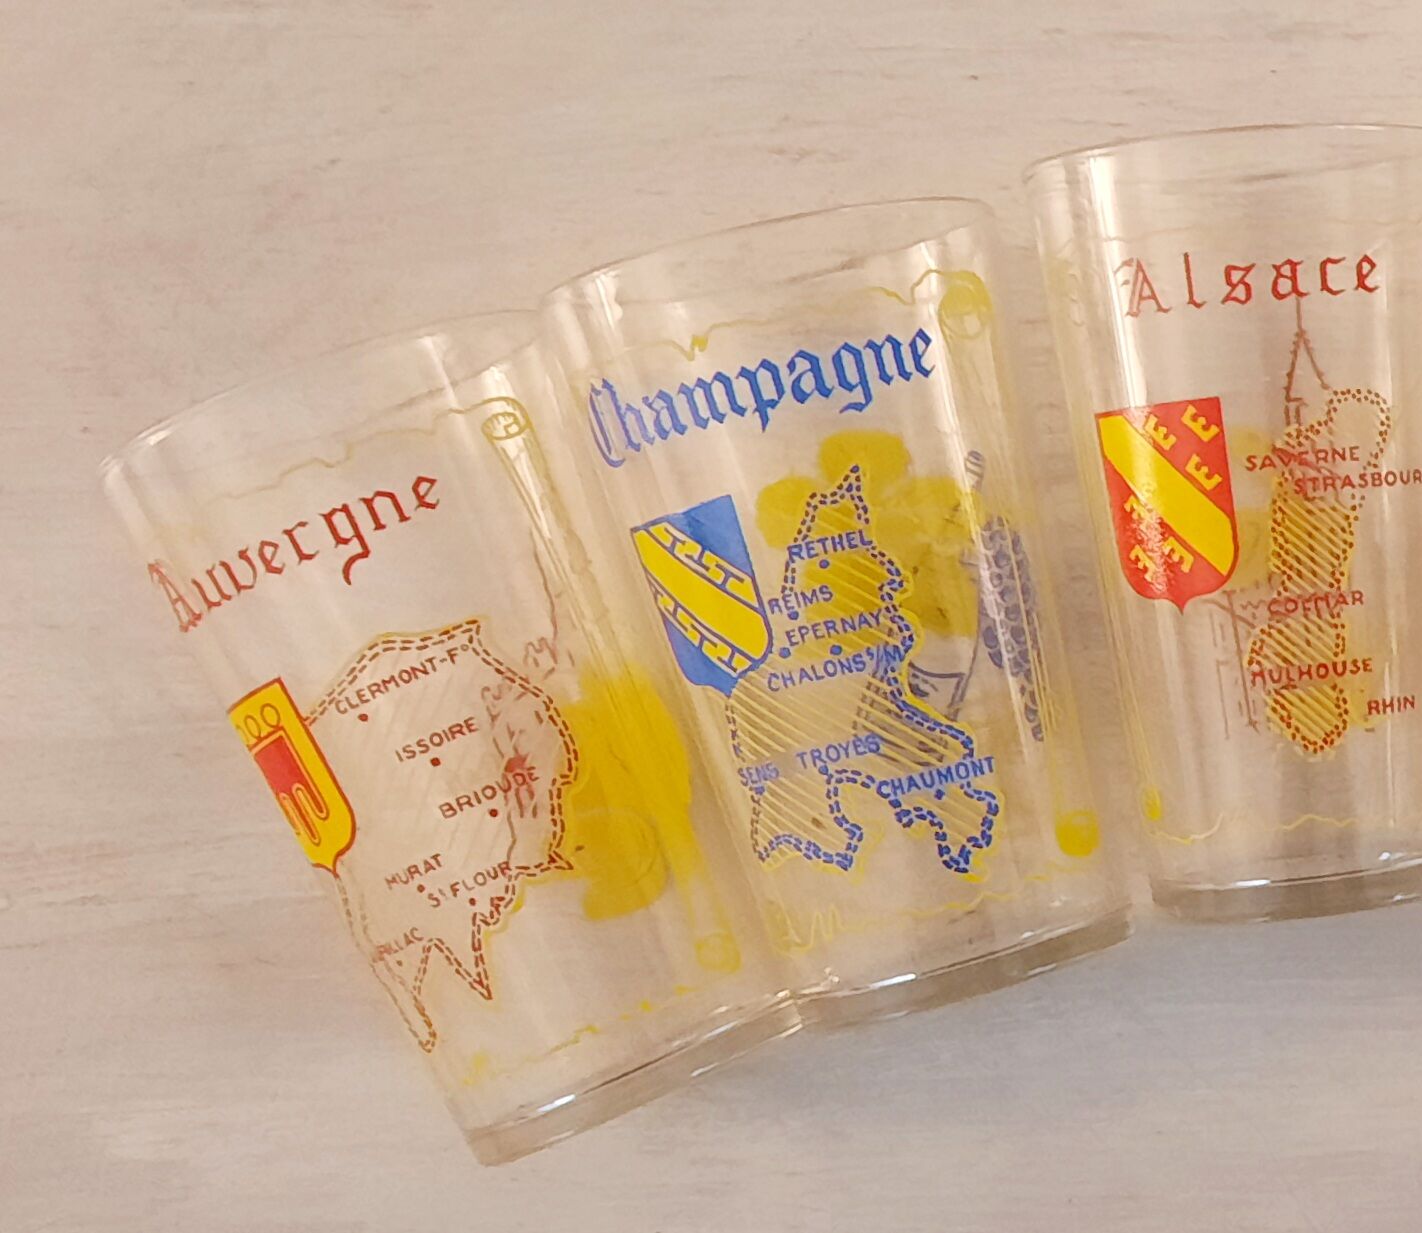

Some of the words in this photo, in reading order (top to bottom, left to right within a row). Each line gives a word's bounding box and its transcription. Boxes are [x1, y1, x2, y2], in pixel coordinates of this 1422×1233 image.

[1115, 252, 1381, 317] Alsace
[588, 327, 936, 467] Champagne
[1245, 446, 1360, 471] SAVERNE
[147, 475, 440, 633] Auvergne
[788, 529, 873, 563] RETHEL
[768, 585, 834, 615] REIMS
[785, 608, 882, 647] EPERNAY
[1251, 657, 1373, 688] MULHOUSE
[1367, 695, 1416, 715] RHIN
[395, 716, 479, 762] ISSOIRE
[797, 732, 881, 769] TROYES
[438, 766, 539, 819] BRIOUDE
[876, 756, 995, 798] CHAUMONT
[385, 853, 443, 890] MURAT
